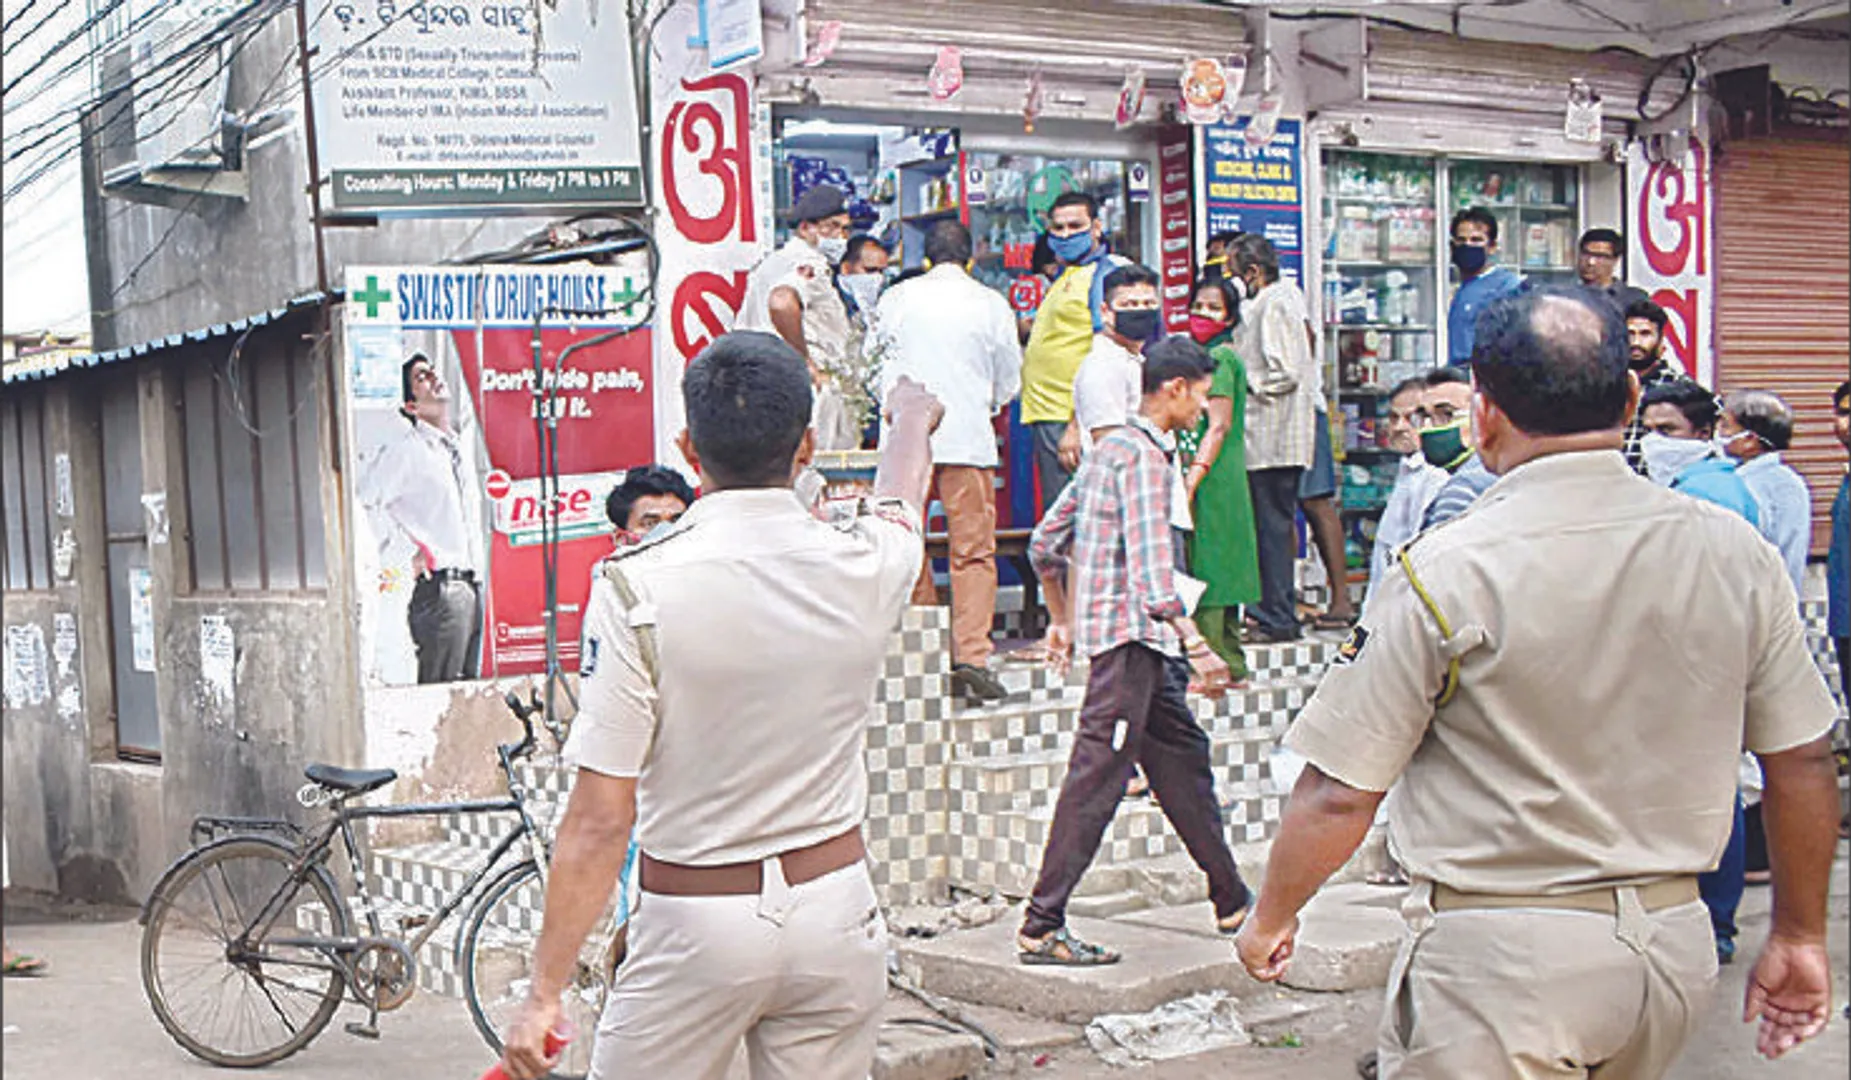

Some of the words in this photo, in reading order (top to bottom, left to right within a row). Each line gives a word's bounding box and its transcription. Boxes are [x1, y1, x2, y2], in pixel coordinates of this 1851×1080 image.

[401, 65, 446, 78] Medical
[342, 86, 395, 99] Assistant
[342, 103, 365, 118] Life
[367, 104, 414, 117] Member
[495, 103, 539, 117] Medical
[343, 172, 413, 195] Consulting
[457, 171, 504, 195] Monday
[519, 170, 557, 194] Friday
[567, 170, 587, 188] PM
[612, 170, 632, 187] PM
[494, 273, 544, 320] DRUG
[546, 275, 606, 320] HOUSE
[482, 368, 538, 391] Don't
[591, 366, 645, 394] pain,
[570, 396, 592, 418] it.
[511, 487, 592, 521] nse
